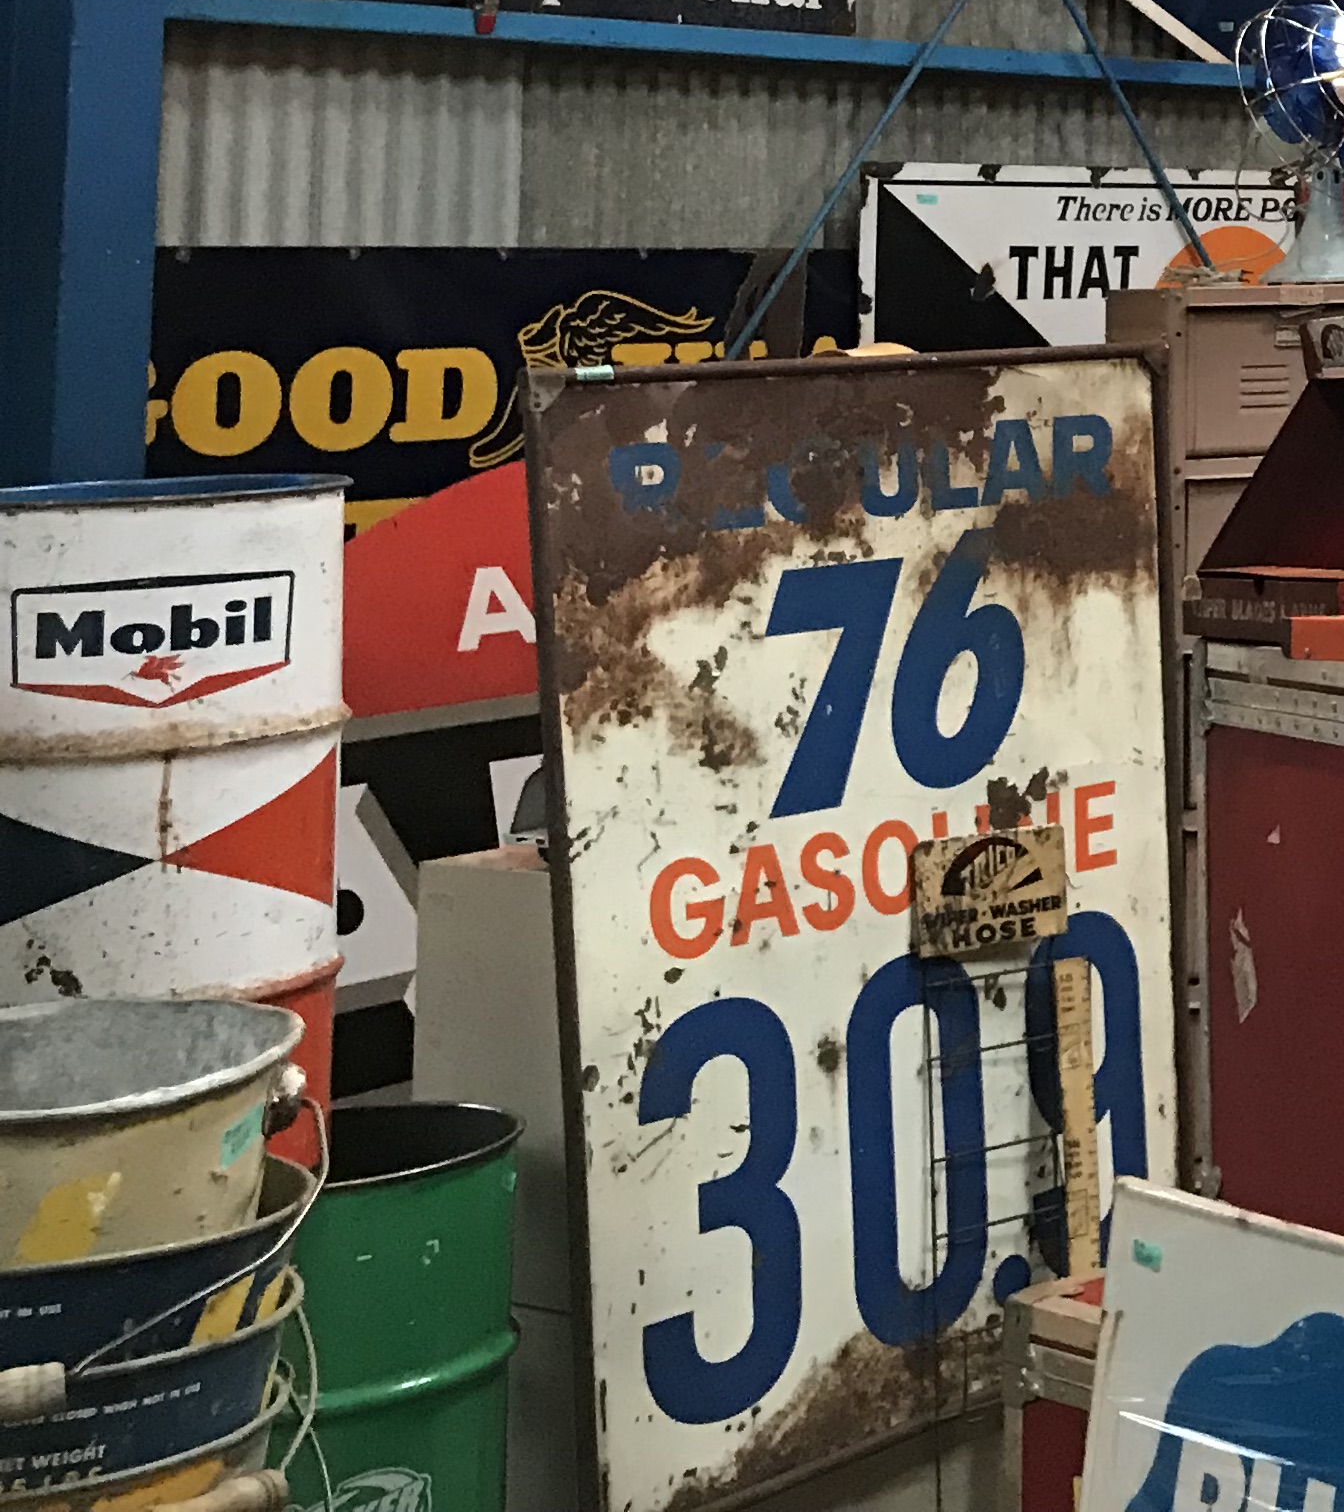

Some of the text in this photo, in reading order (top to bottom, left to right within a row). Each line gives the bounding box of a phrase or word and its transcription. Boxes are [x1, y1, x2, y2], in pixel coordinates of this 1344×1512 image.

[1056, 194, 1132, 224] There
[1137, 196, 1161, 223] is
[1008, 244, 1140, 301] THAT
[145, 346, 498, 458] OOD
[36, 595, 272, 659] Mobil
[764, 525, 1025, 821] 76
[648, 780, 1118, 960] GASOE
[952, 917, 1036, 948] HOSE
[31, 1444, 106, 1469] WEIGHT
